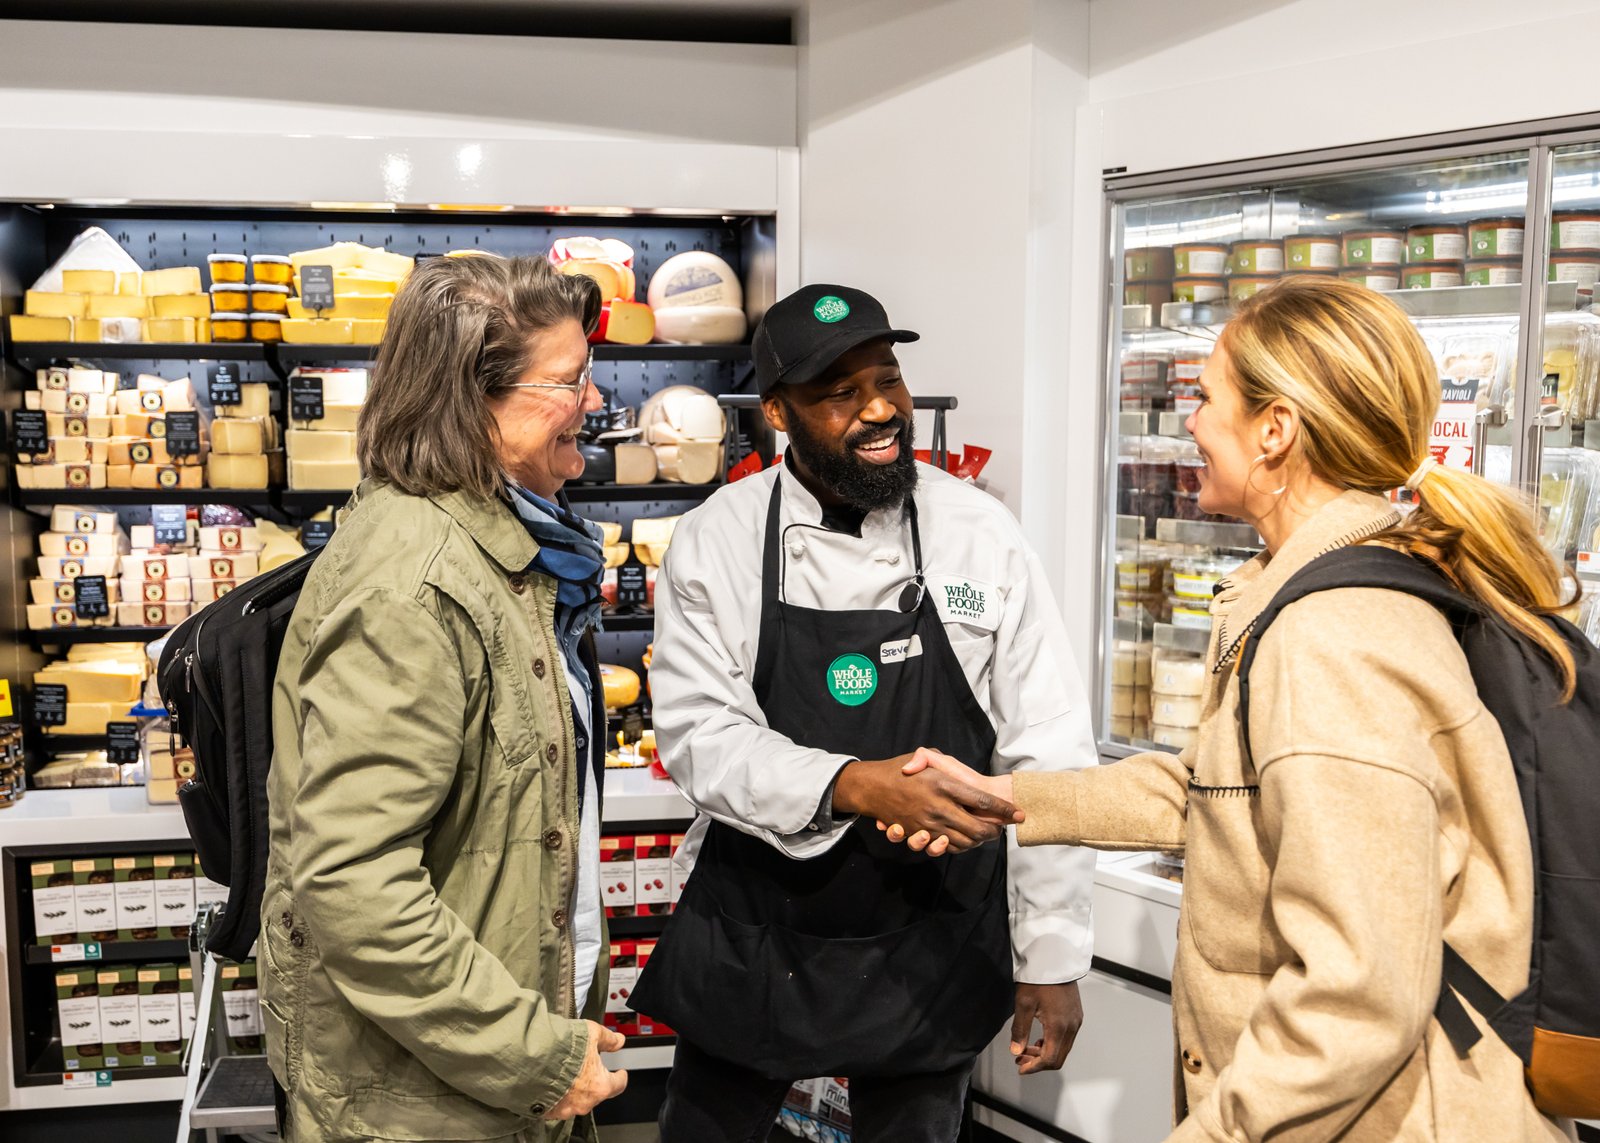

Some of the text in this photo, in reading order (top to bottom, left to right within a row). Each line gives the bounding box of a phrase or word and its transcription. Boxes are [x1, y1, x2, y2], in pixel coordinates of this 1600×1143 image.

[1442, 389, 1472, 401] RAVIOLI
[1430, 422, 1468, 438] OCAL
[944, 585, 985, 602] WHOLE
[947, 597, 985, 613] FOODS
[951, 610, 981, 619] MARKET
[832, 667, 873, 680] WHOLE
[835, 678, 873, 690] FOODS
